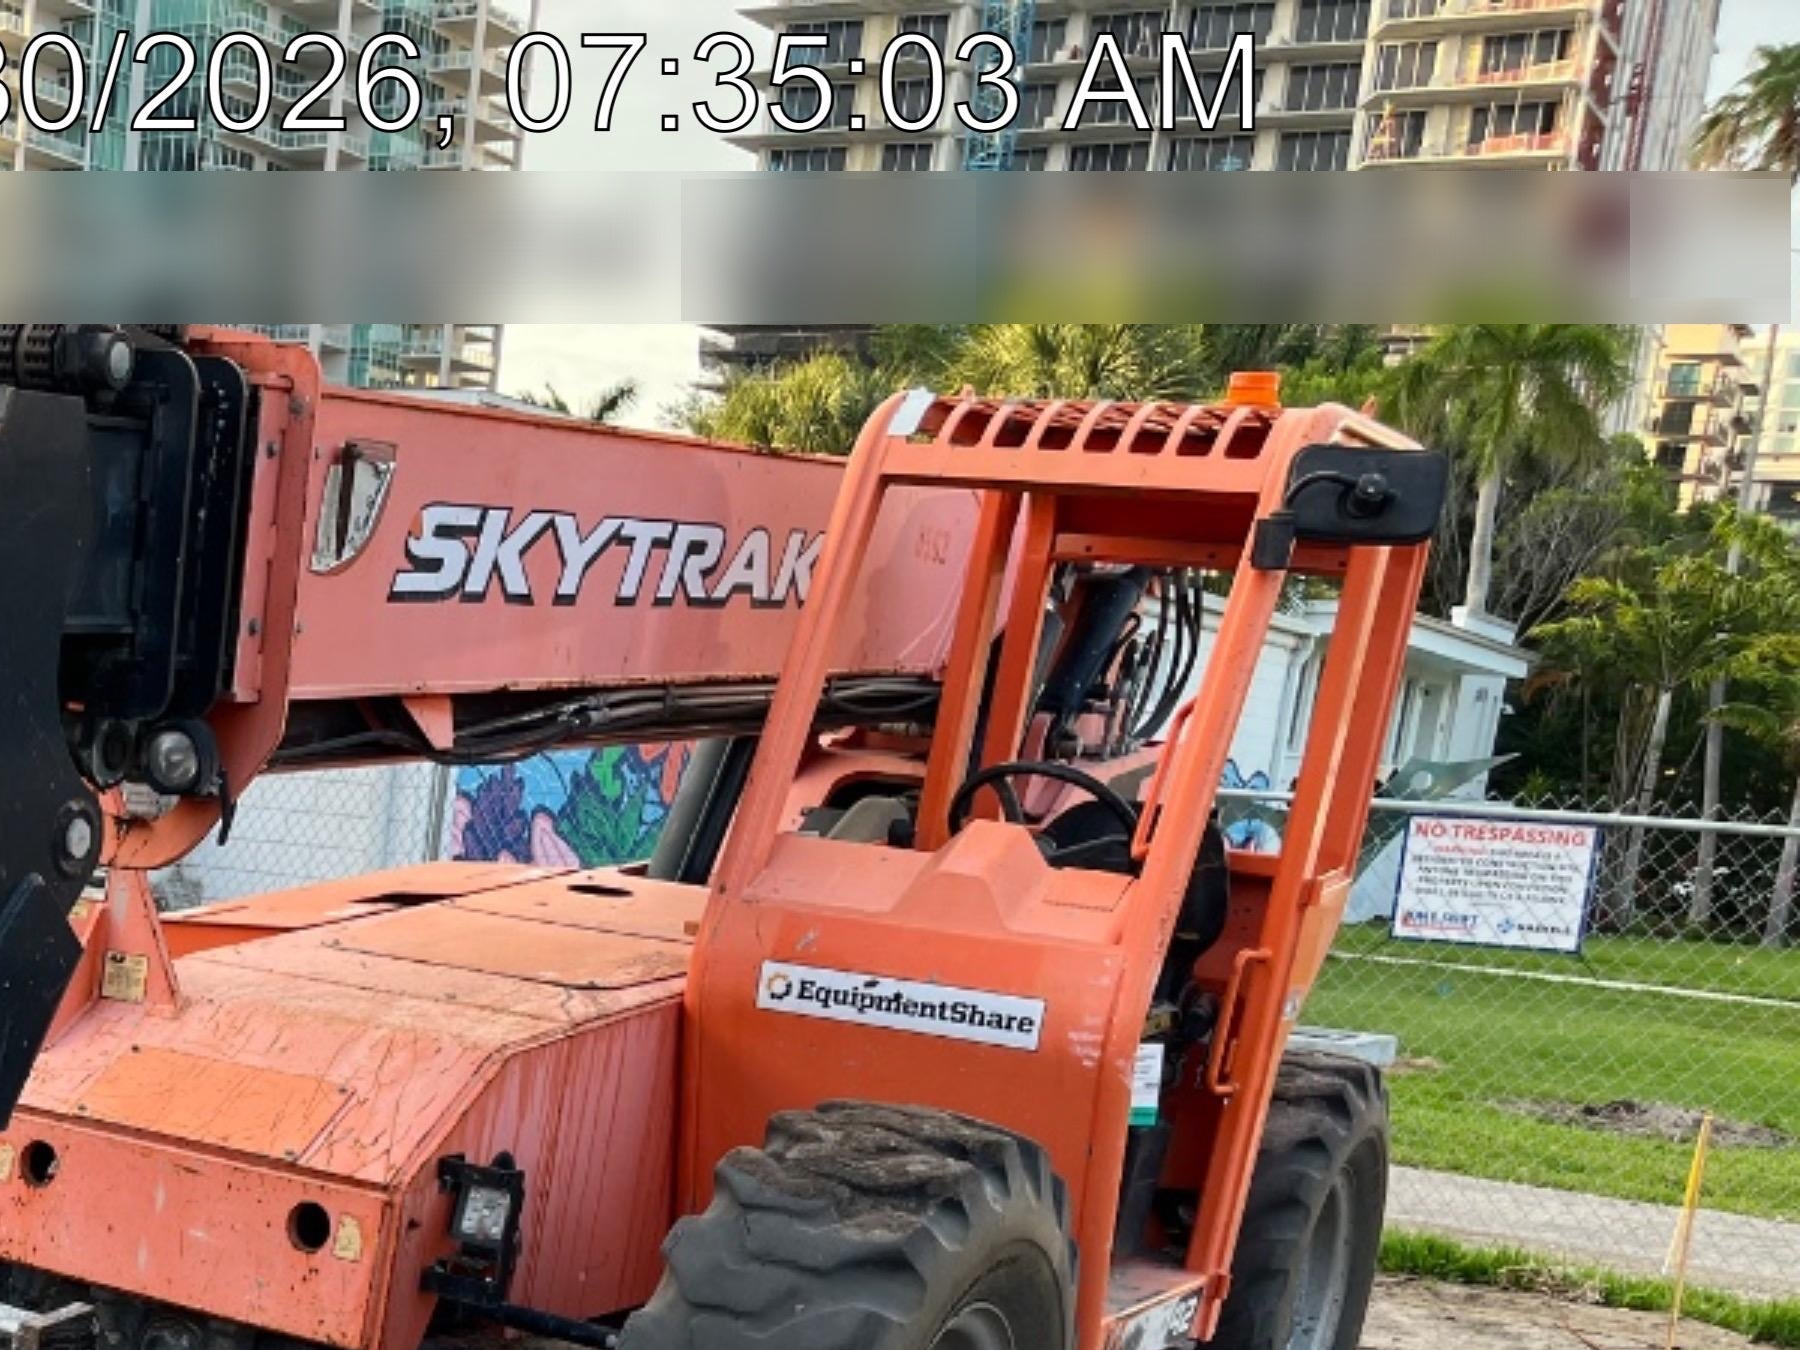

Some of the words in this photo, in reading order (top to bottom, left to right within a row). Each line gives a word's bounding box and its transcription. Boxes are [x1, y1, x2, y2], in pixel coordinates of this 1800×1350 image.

[387, 501, 828, 608] SKYTRAK
[1415, 822, 1446, 838] NO
[1453, 825, 1586, 846] TRESPASSING
[796, 978, 1037, 1035] EquipmentShare
